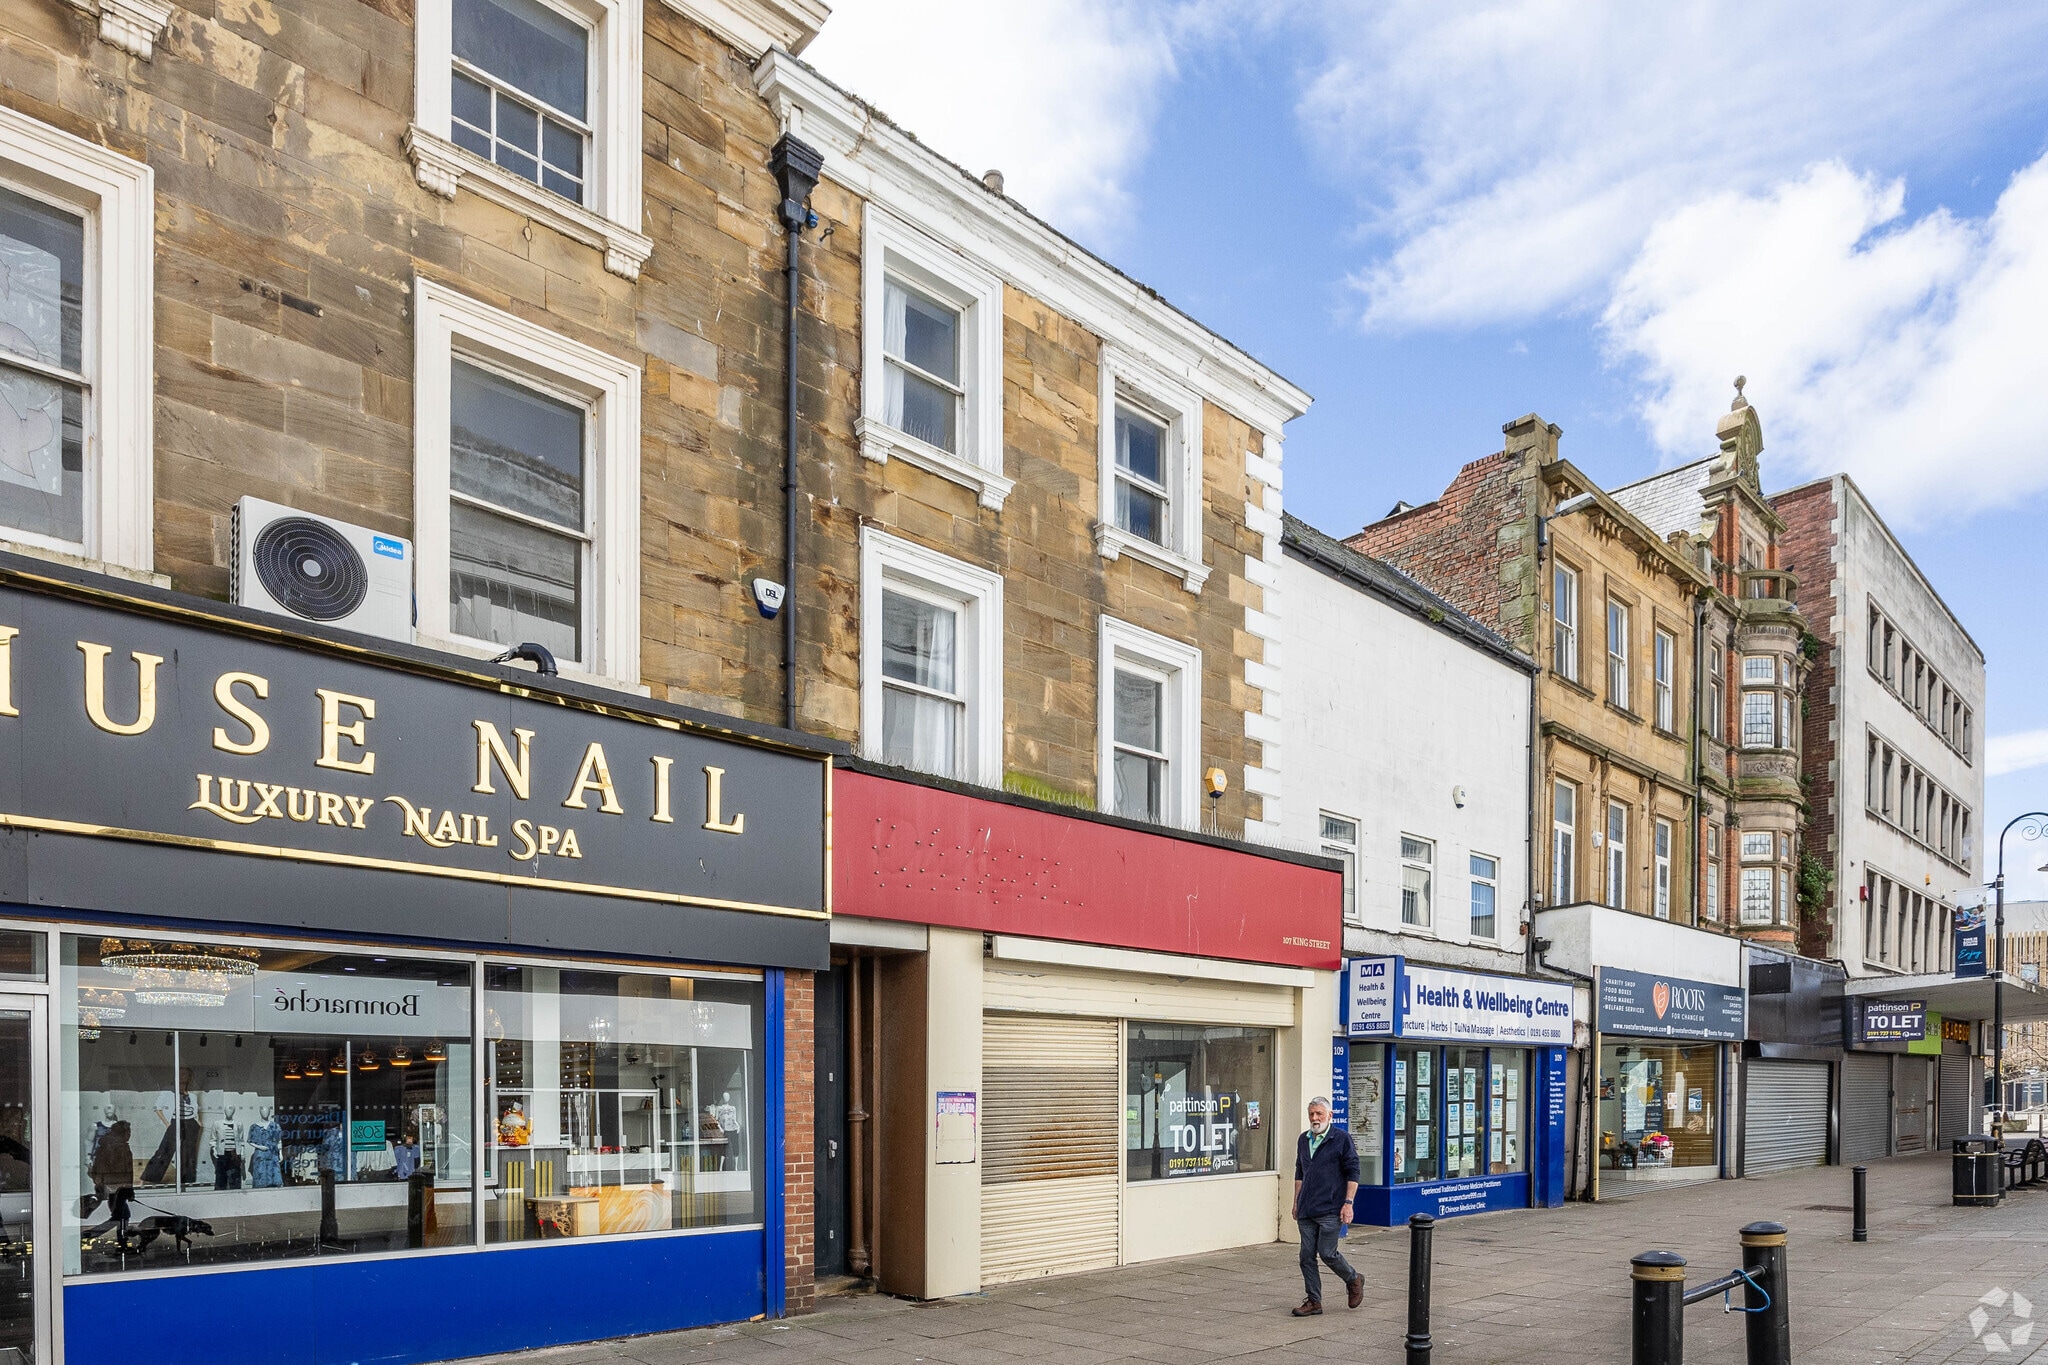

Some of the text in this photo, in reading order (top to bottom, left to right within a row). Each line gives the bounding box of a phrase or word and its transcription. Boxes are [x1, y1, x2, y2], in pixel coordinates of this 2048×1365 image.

[0, 625, 744, 835] USE NAIL
[187, 774, 583, 861] LUXURY NAIL SPA
[1282, 936, 1330, 949] 107 KING STREET
[1359, 982, 1385, 992] Health &
[1357, 997, 1386, 1006] Wellbeing
[1417, 984, 1459, 1008] Health
[1463, 988, 1473, 1010] &
[1476, 991, 1532, 1018] Wellbeing
[1536, 996, 1569, 1017] Centre
[1672, 986, 1705, 1011] ROOTS
[1868, 1004, 1909, 1013] pattinson
[1868, 1015, 1922, 1028] TO LET
[1430, 1022, 1448, 1032] Herbs
[1500, 1025, 1526, 1036] Aesthetics
[1530, 1028, 1541, 1037] 0191
[1334, 1046, 1344, 1055] 109
[938, 1103, 974, 1112] FUNFAIR
[1170, 1097, 1217, 1115] pattinson
[1170, 1123, 1233, 1153] TO LET
[1170, 1158, 1184, 1168] 0191
[1185, 1158, 1196, 1167] 737
[1198, 1157, 1211, 1166] 1154
[1422, 1186, 1441, 1196] Experienced
[1442, 1184, 1457, 1193] Traditional
[1458, 1183, 1469, 1191] Chinese
[1445, 1205, 1459, 1213] Chinese
[1460, 1203, 1476, 1211] Medicine
[1476, 1202, 1486, 1210] Clinic
